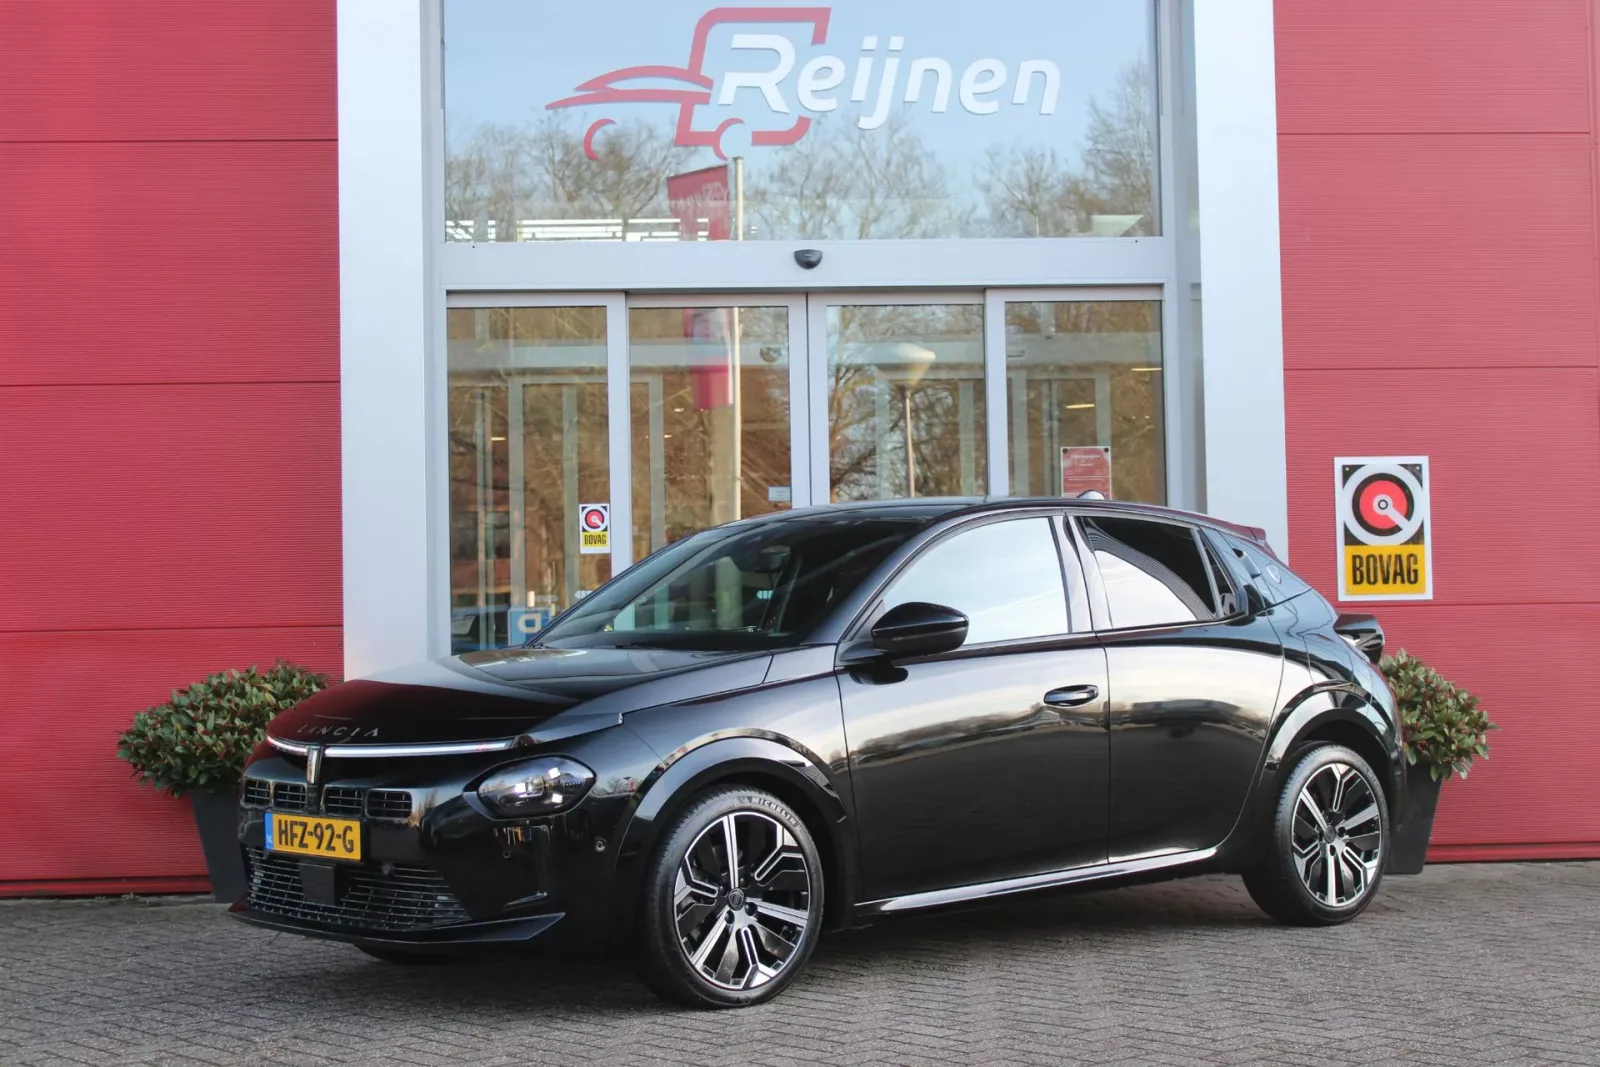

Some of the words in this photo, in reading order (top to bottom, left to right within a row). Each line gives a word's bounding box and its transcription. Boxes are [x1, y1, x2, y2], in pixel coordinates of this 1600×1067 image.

[717, 34, 1061, 130] Reijnen
[584, 534, 607, 545] BOVAG
[1352, 553, 1418, 585] BOVAG
[751, 797, 797, 825] MICHELIN
[278, 818, 355, 853] HFZ-92-G
